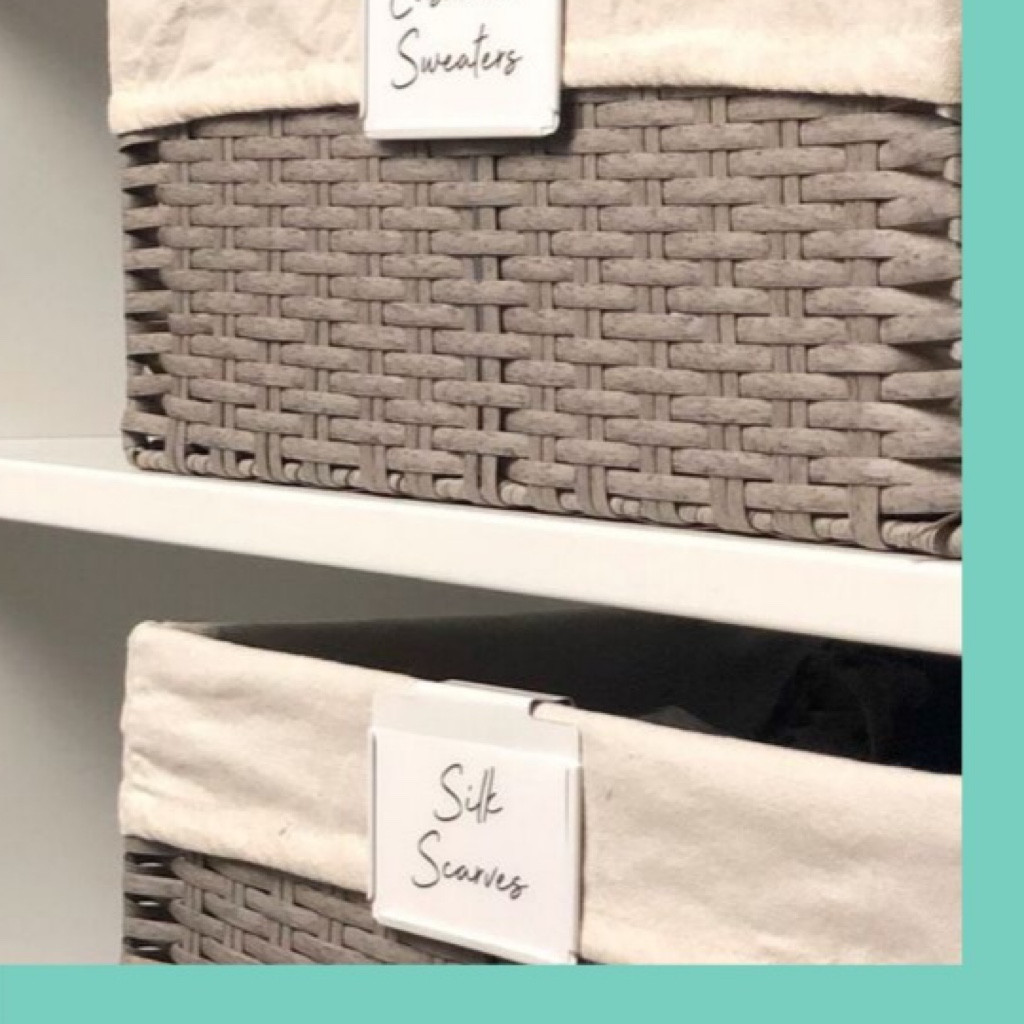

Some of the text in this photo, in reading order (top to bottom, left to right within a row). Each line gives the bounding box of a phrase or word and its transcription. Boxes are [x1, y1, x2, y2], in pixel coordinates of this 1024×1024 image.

[390, 23, 522, 89] Sweaters
[433, 762, 503, 823] Silk
[411, 829, 529, 900] Scarves
